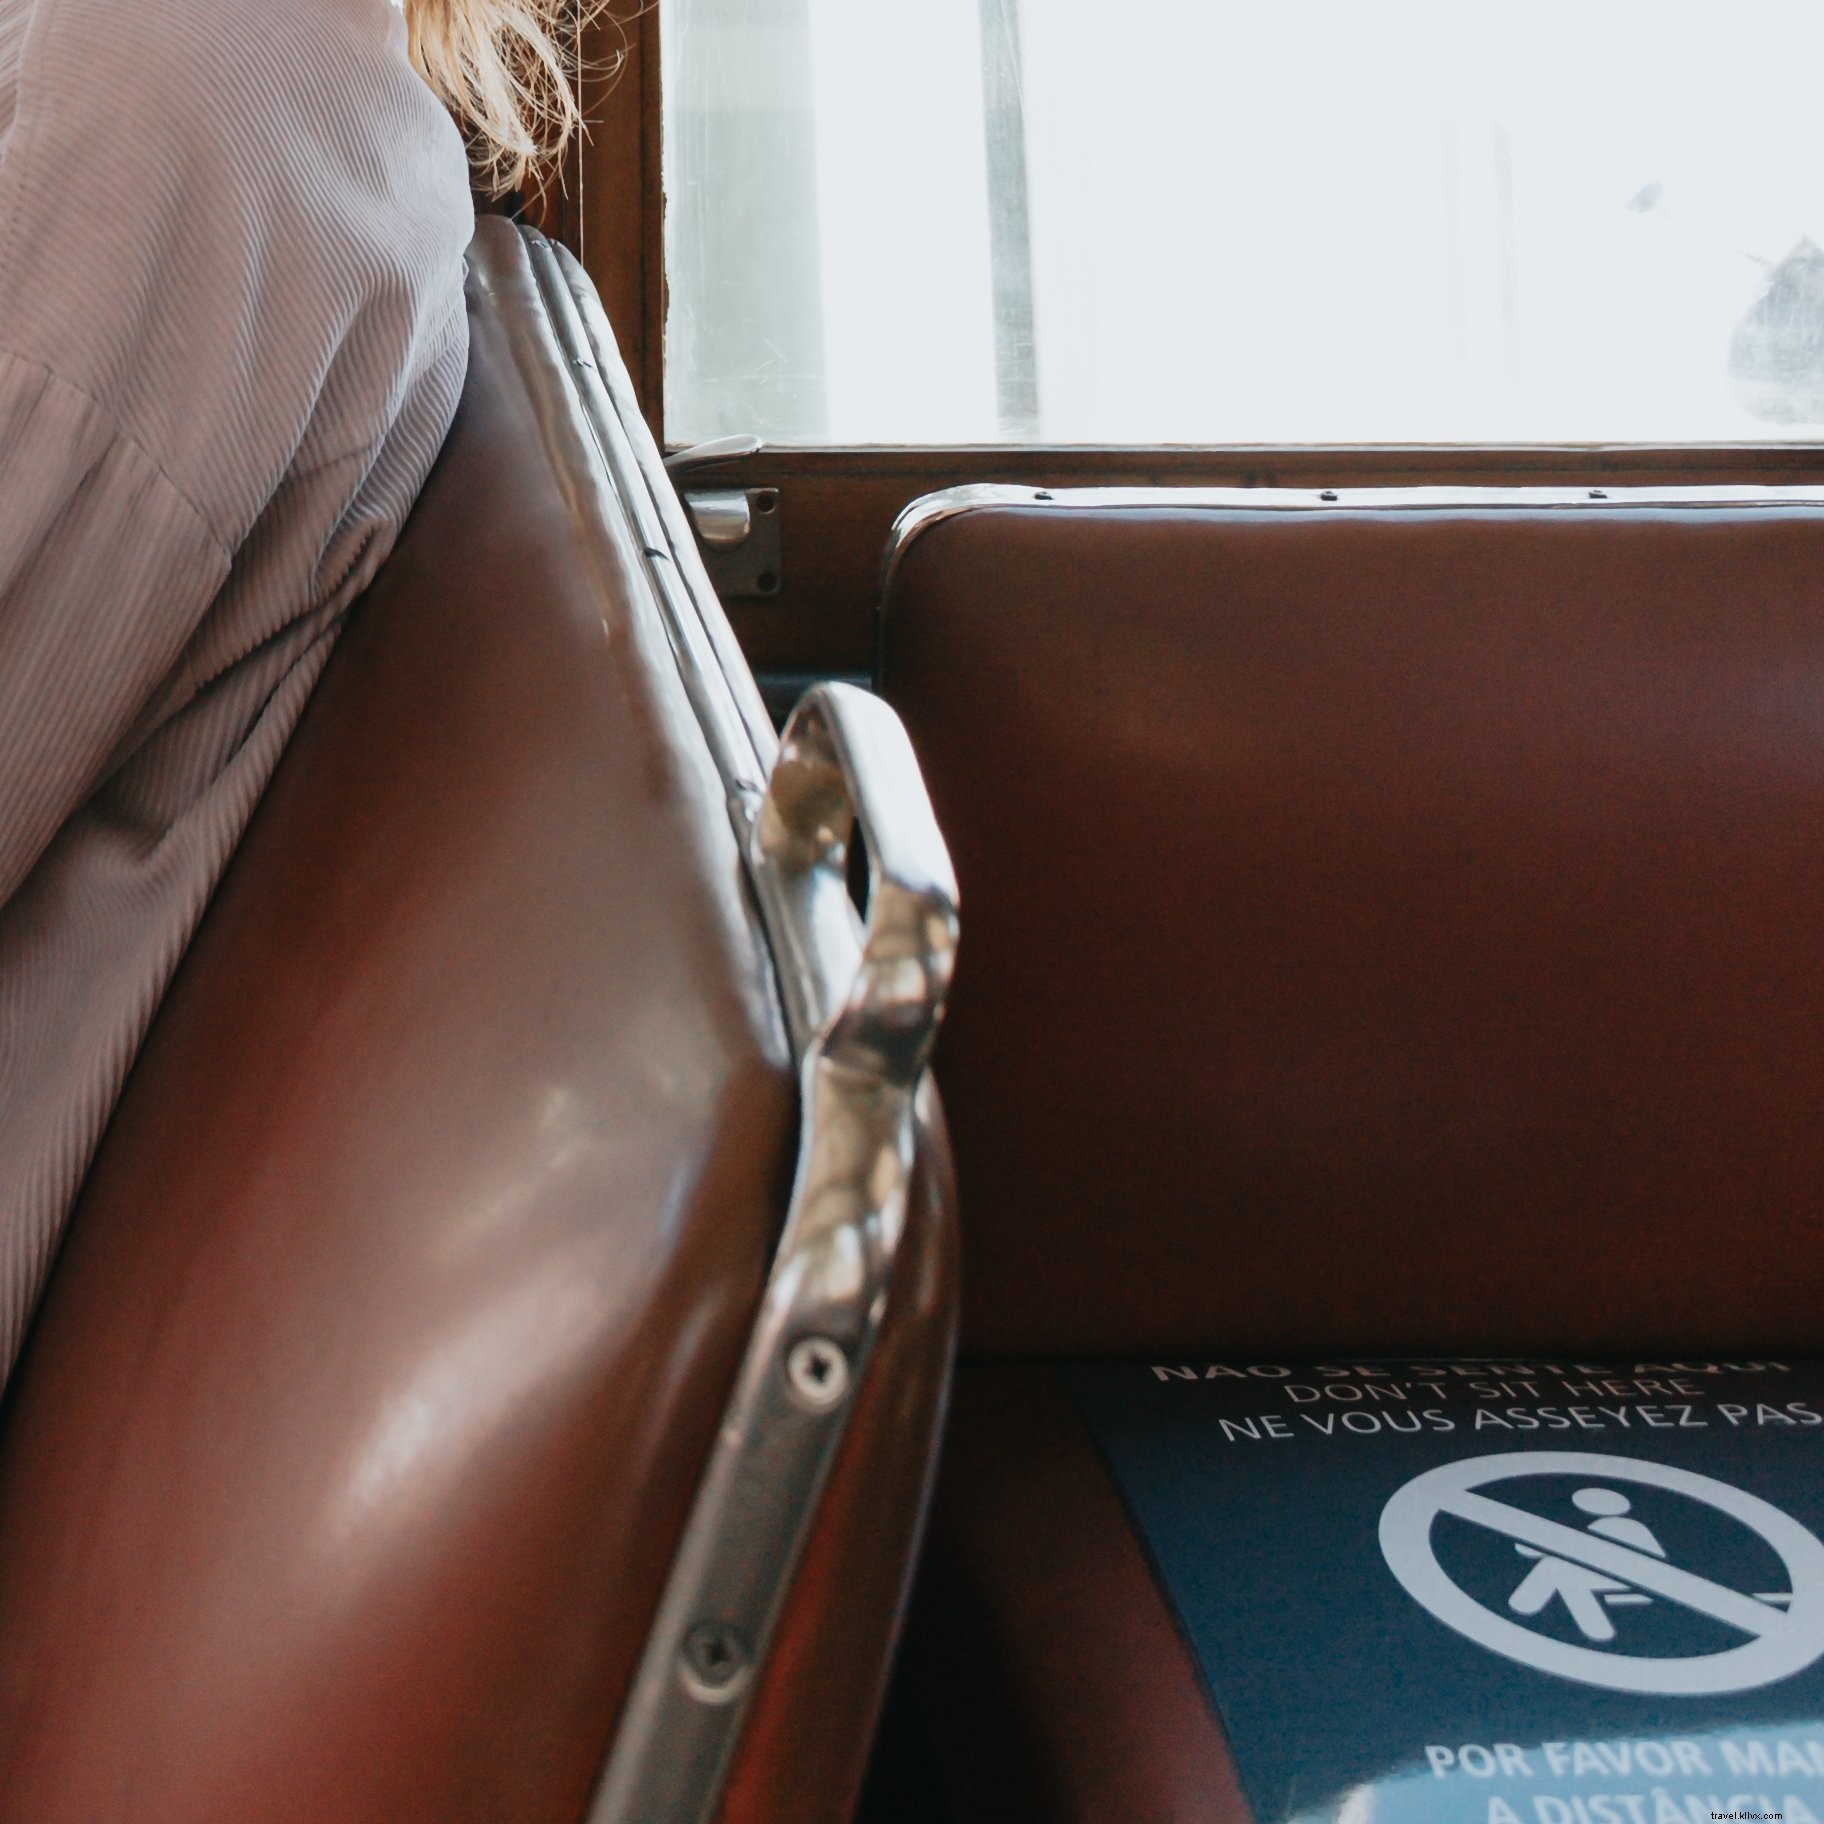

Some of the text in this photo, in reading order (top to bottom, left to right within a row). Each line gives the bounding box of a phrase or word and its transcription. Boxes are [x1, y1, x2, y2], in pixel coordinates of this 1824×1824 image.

[1283, 1378, 1705, 1402] DON'T SIT HERE
[1218, 1402, 1824, 1441] NE VOUS ASSEYEZ PAS
[1424, 1743, 1534, 1779] POR
[1541, 1741, 1713, 1777] FAVOR
[1488, 1796, 1524, 1824] A
